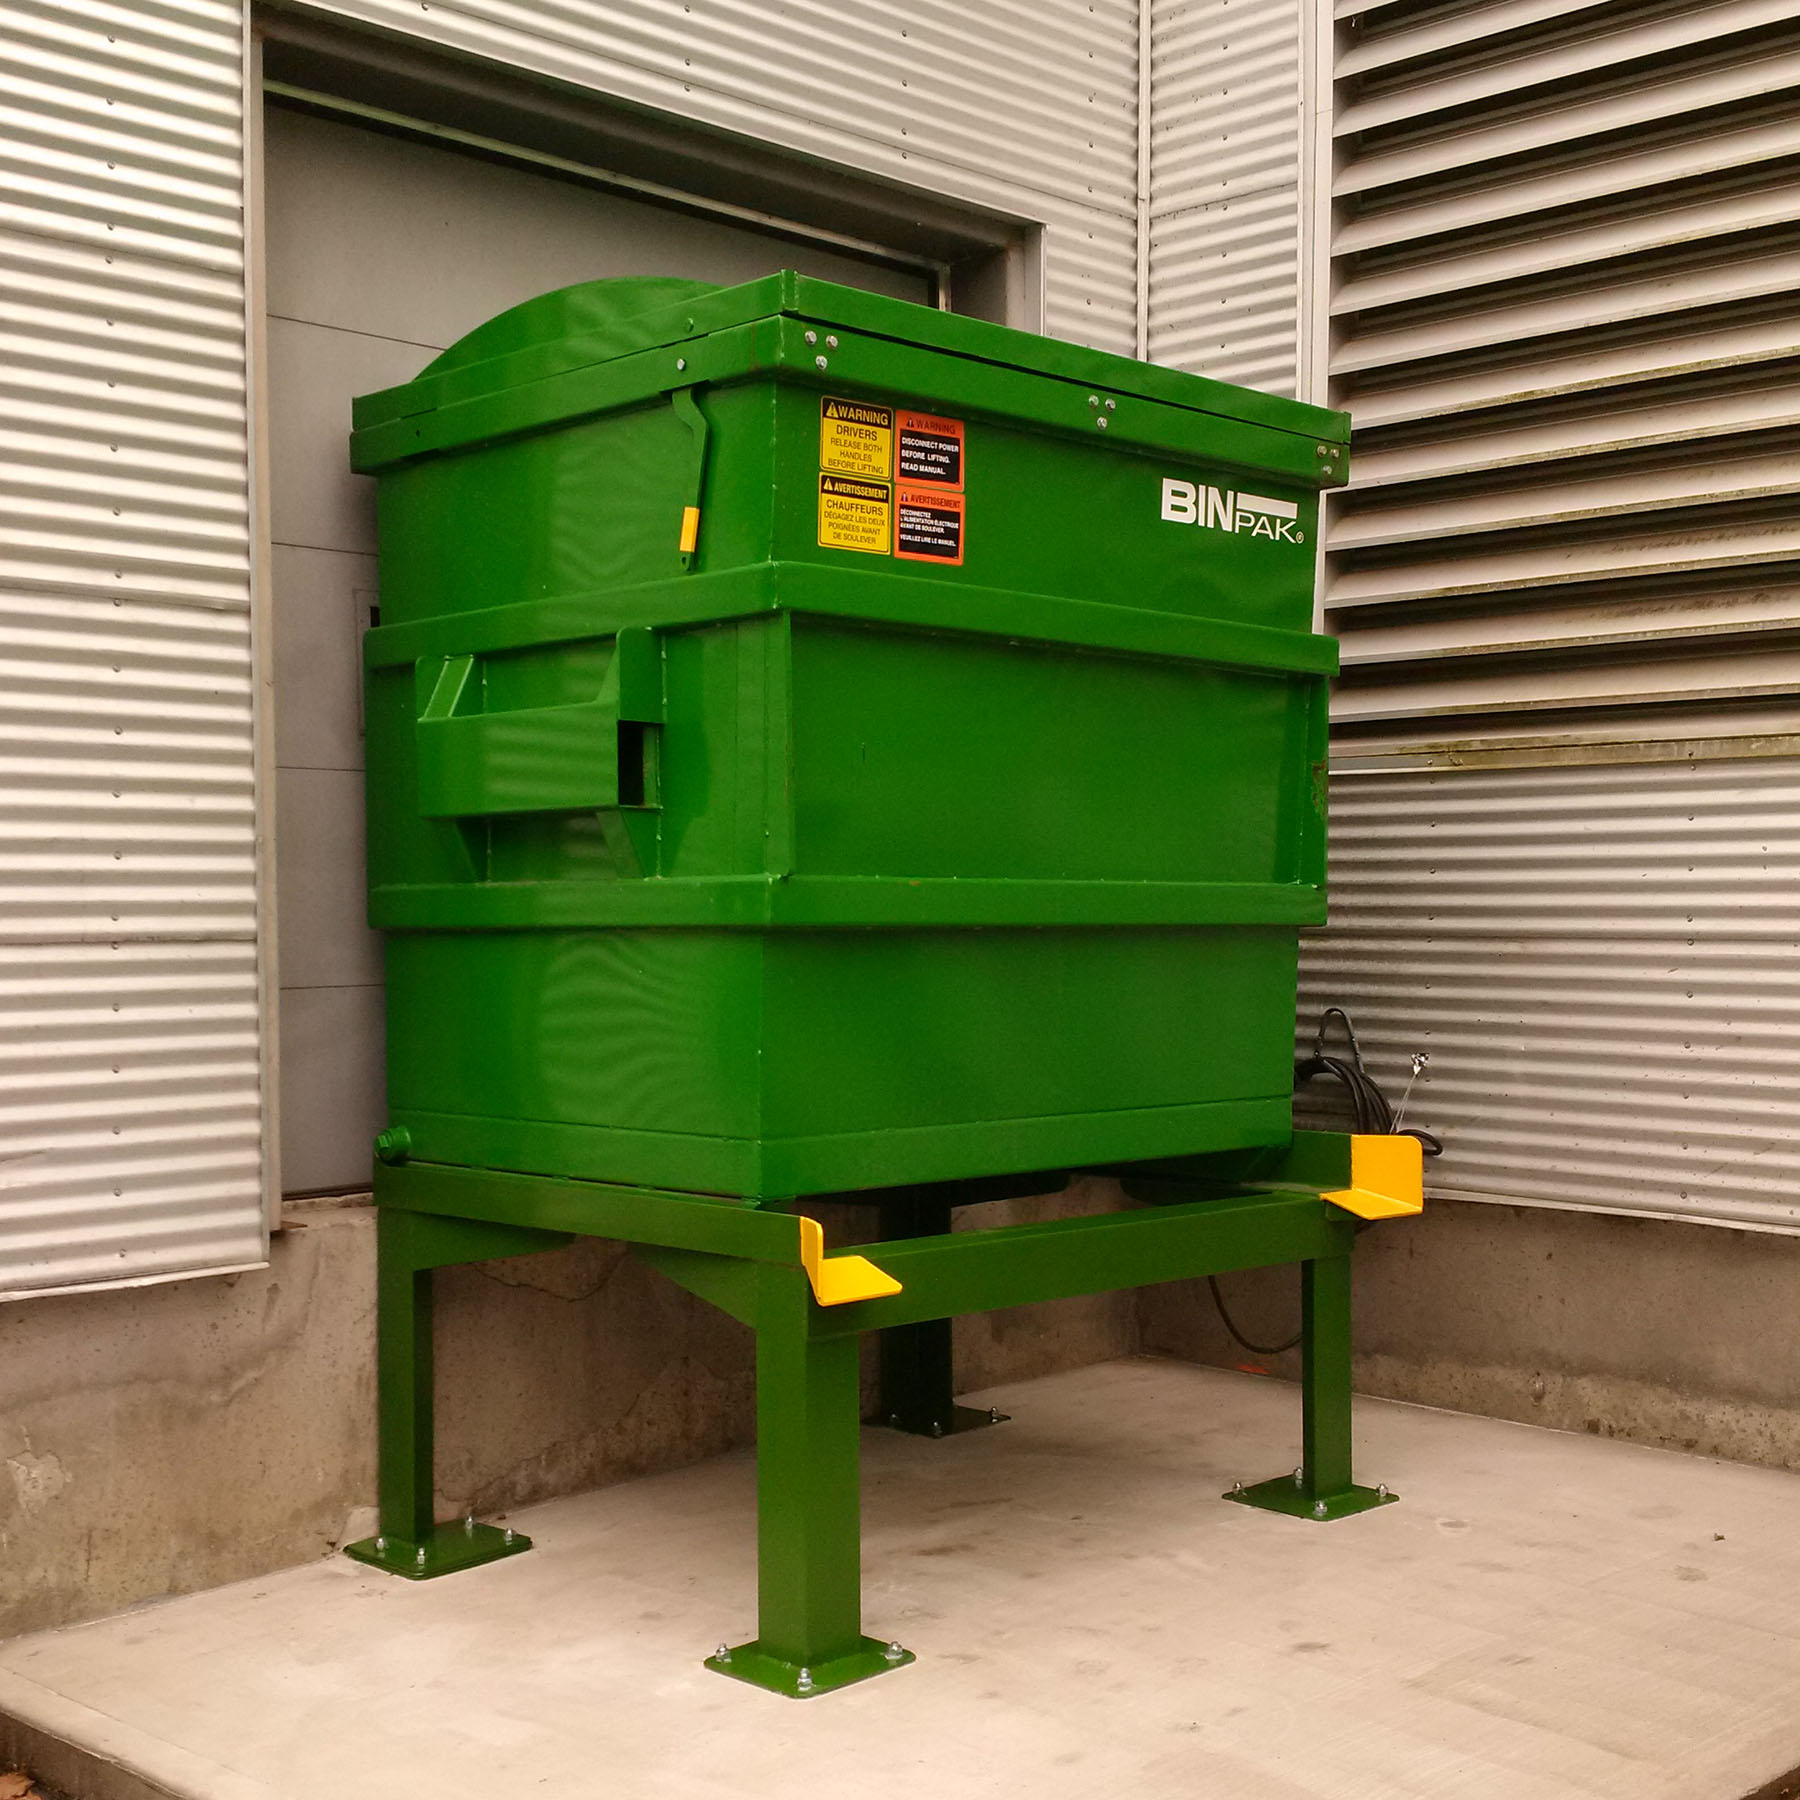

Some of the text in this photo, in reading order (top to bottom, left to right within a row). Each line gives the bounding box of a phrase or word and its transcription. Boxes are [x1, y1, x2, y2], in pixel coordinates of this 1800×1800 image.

[838, 405, 888, 425] WARNING
[836, 425, 877, 441] DRIVERS
[916, 418, 955, 434] WARNING
[831, 438, 882, 452] RELEASE BOTH
[902, 437, 959, 452] DISCONNECT POWER
[840, 450, 872, 462] HANDLES
[902, 450, 925, 460] BEFORE
[828, 459, 883, 474] BEFORE LIFTING
[901, 463, 918, 471] READ
[834, 482, 887, 499] AVERTISSEMENT
[826, 499, 883, 516] CHAUFFEURS
[911, 495, 961, 508] AVERTISSEMENT
[824, 511, 854, 521] DÉGAGEZ
[868, 518, 885, 526] DEUX
[828, 522, 880, 535] POIGNÉES AVANT
[843, 533, 876, 544] SOULEVER
